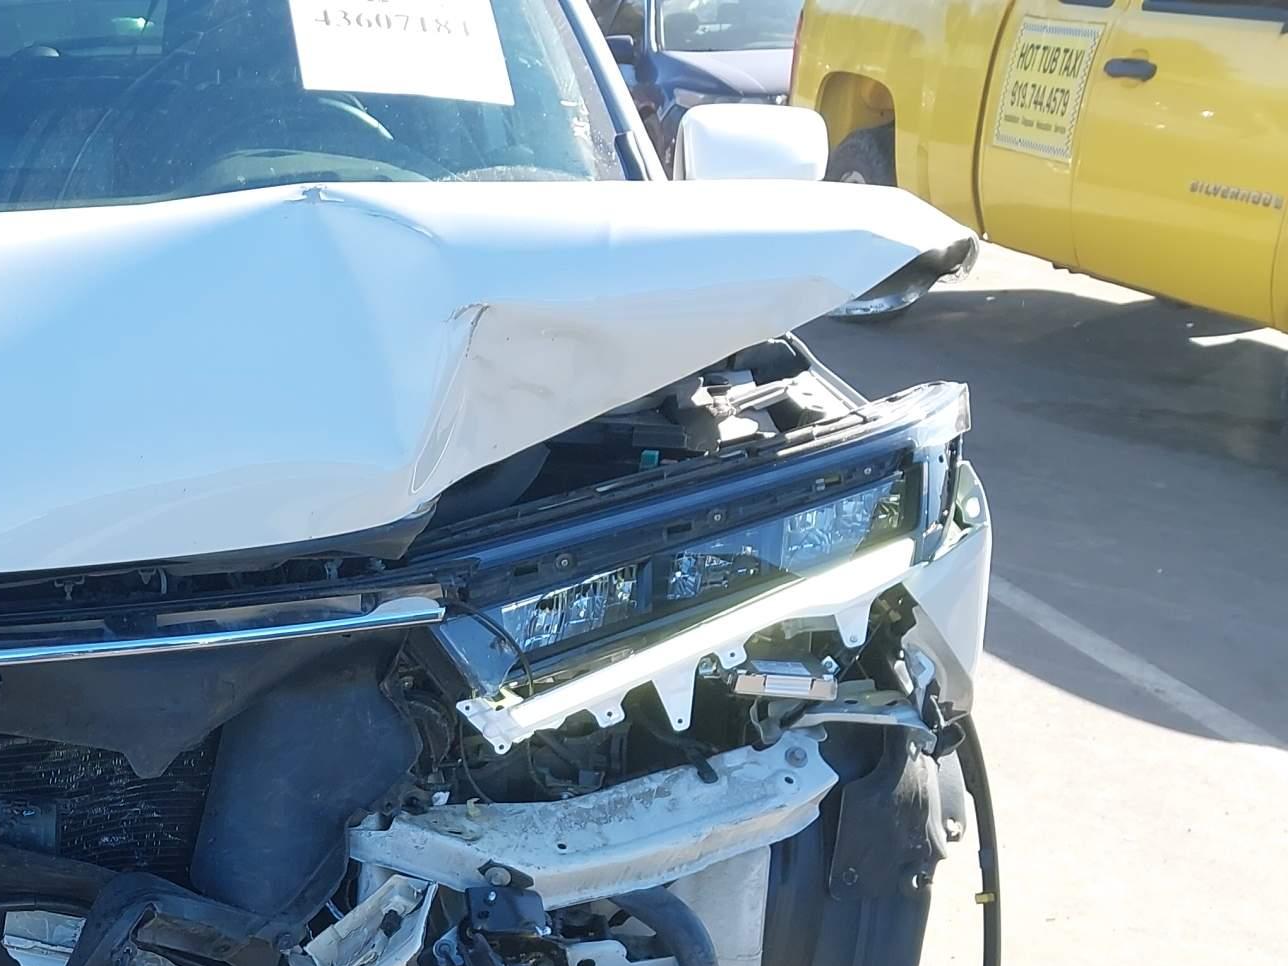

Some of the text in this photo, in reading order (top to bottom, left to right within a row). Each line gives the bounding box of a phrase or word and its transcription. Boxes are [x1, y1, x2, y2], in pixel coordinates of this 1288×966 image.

[1016, 42, 1086, 79] HOT TUB TAXI
[1010, 80, 1071, 117] 919.744.4579
